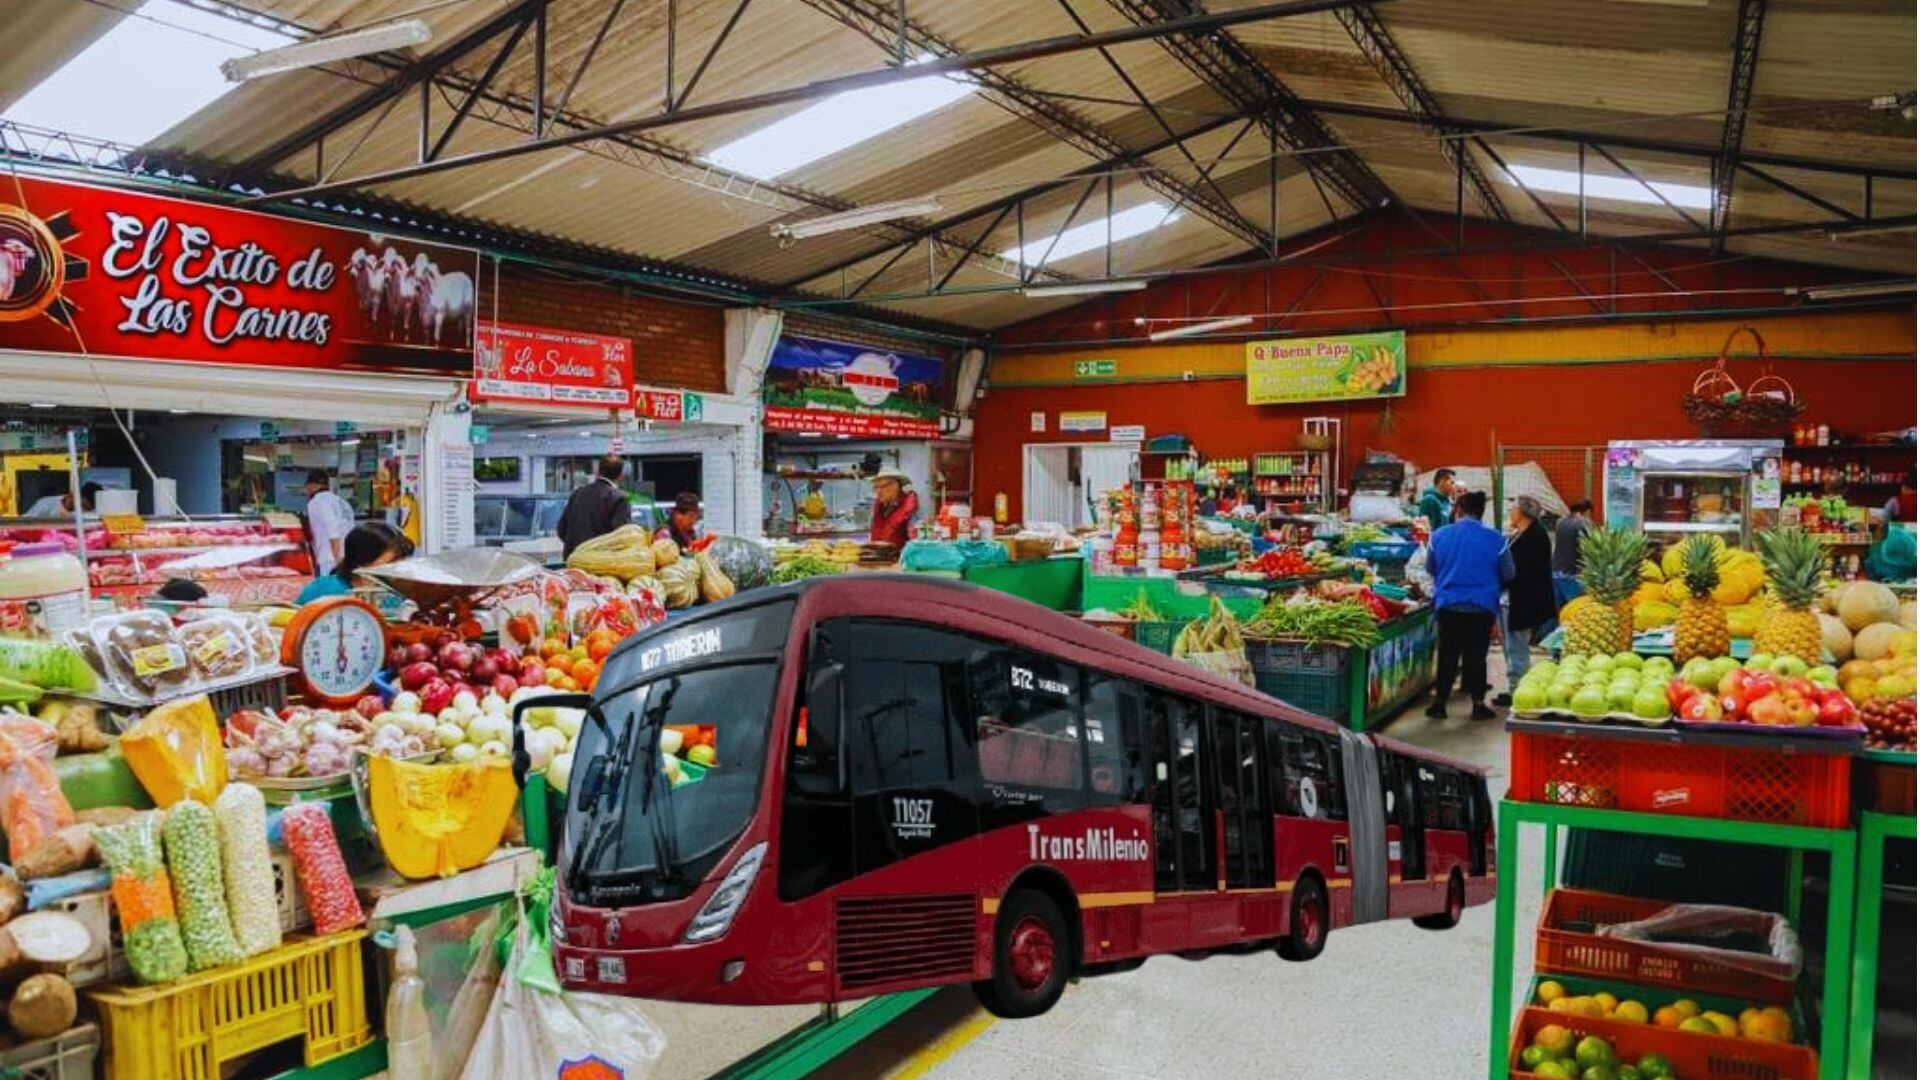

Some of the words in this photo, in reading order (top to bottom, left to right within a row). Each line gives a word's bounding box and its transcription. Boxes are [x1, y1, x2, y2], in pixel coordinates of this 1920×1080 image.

[102, 211, 169, 277] El
[172, 223, 280, 285] Exito
[287, 248, 335, 290] de
[117, 274, 192, 334] Las
[203, 284, 331, 345] Carnes
[538, 348, 596, 378] Sabana
[1317, 342, 1350, 358] Papa
[663, 626, 722, 664] TOBERIN
[893, 797, 934, 823] T1057
[1027, 823, 1149, 861] TransMilenio
